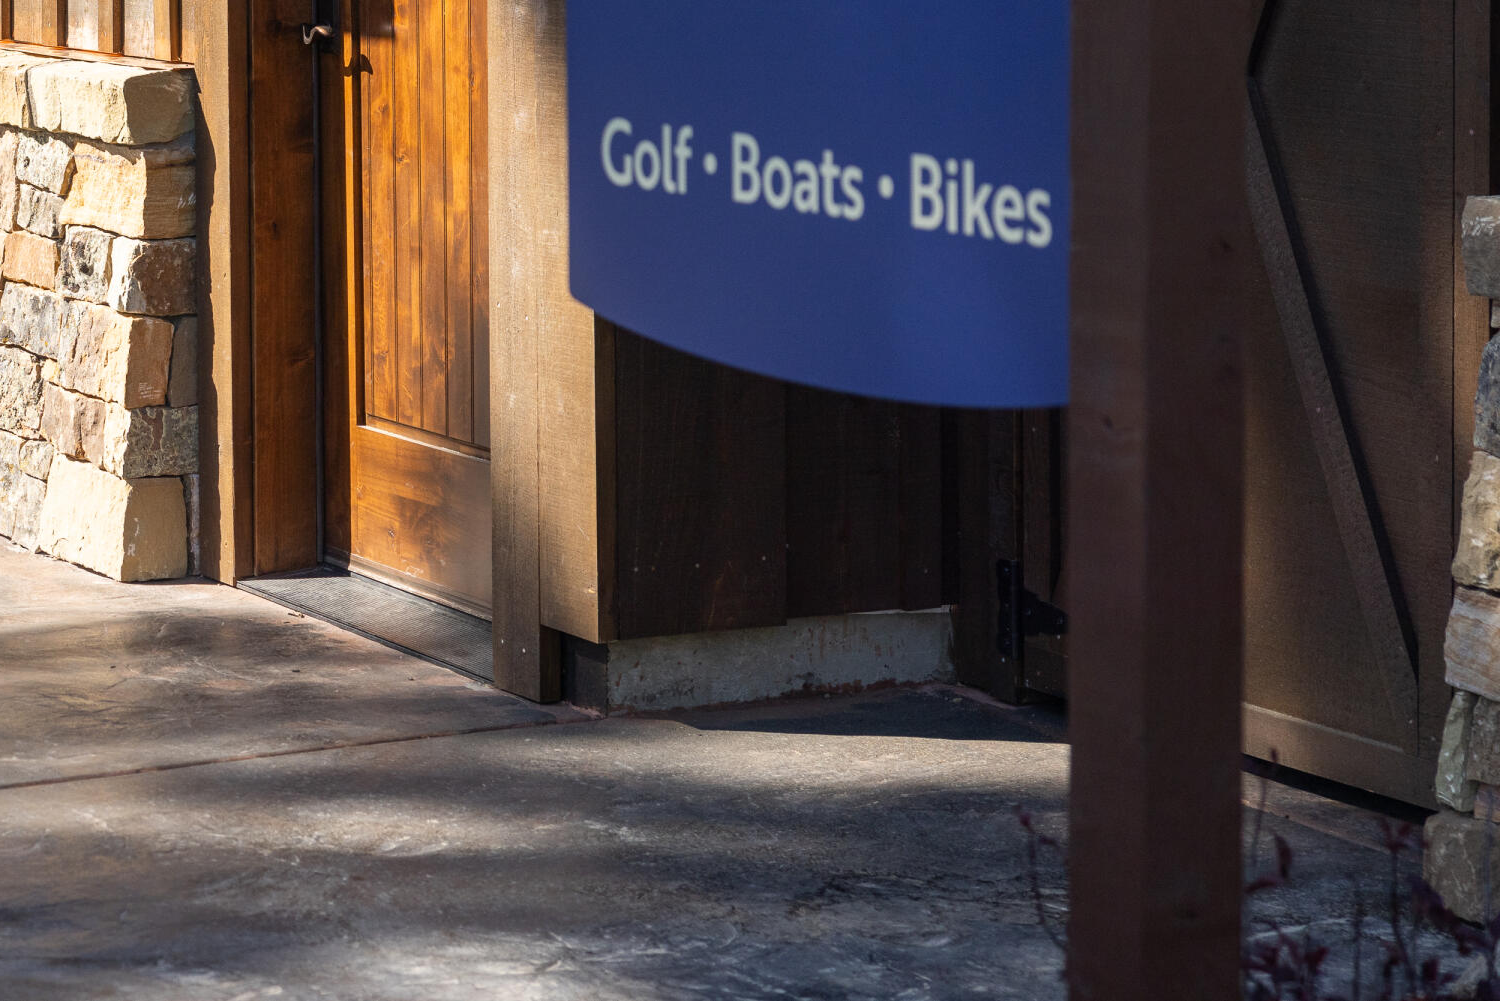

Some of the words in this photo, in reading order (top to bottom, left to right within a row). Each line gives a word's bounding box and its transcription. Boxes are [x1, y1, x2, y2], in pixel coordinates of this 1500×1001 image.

[601, 118, 693, 195] Golf
[731, 132, 864, 221] Boats
[910, 154, 1053, 248] Bikes
